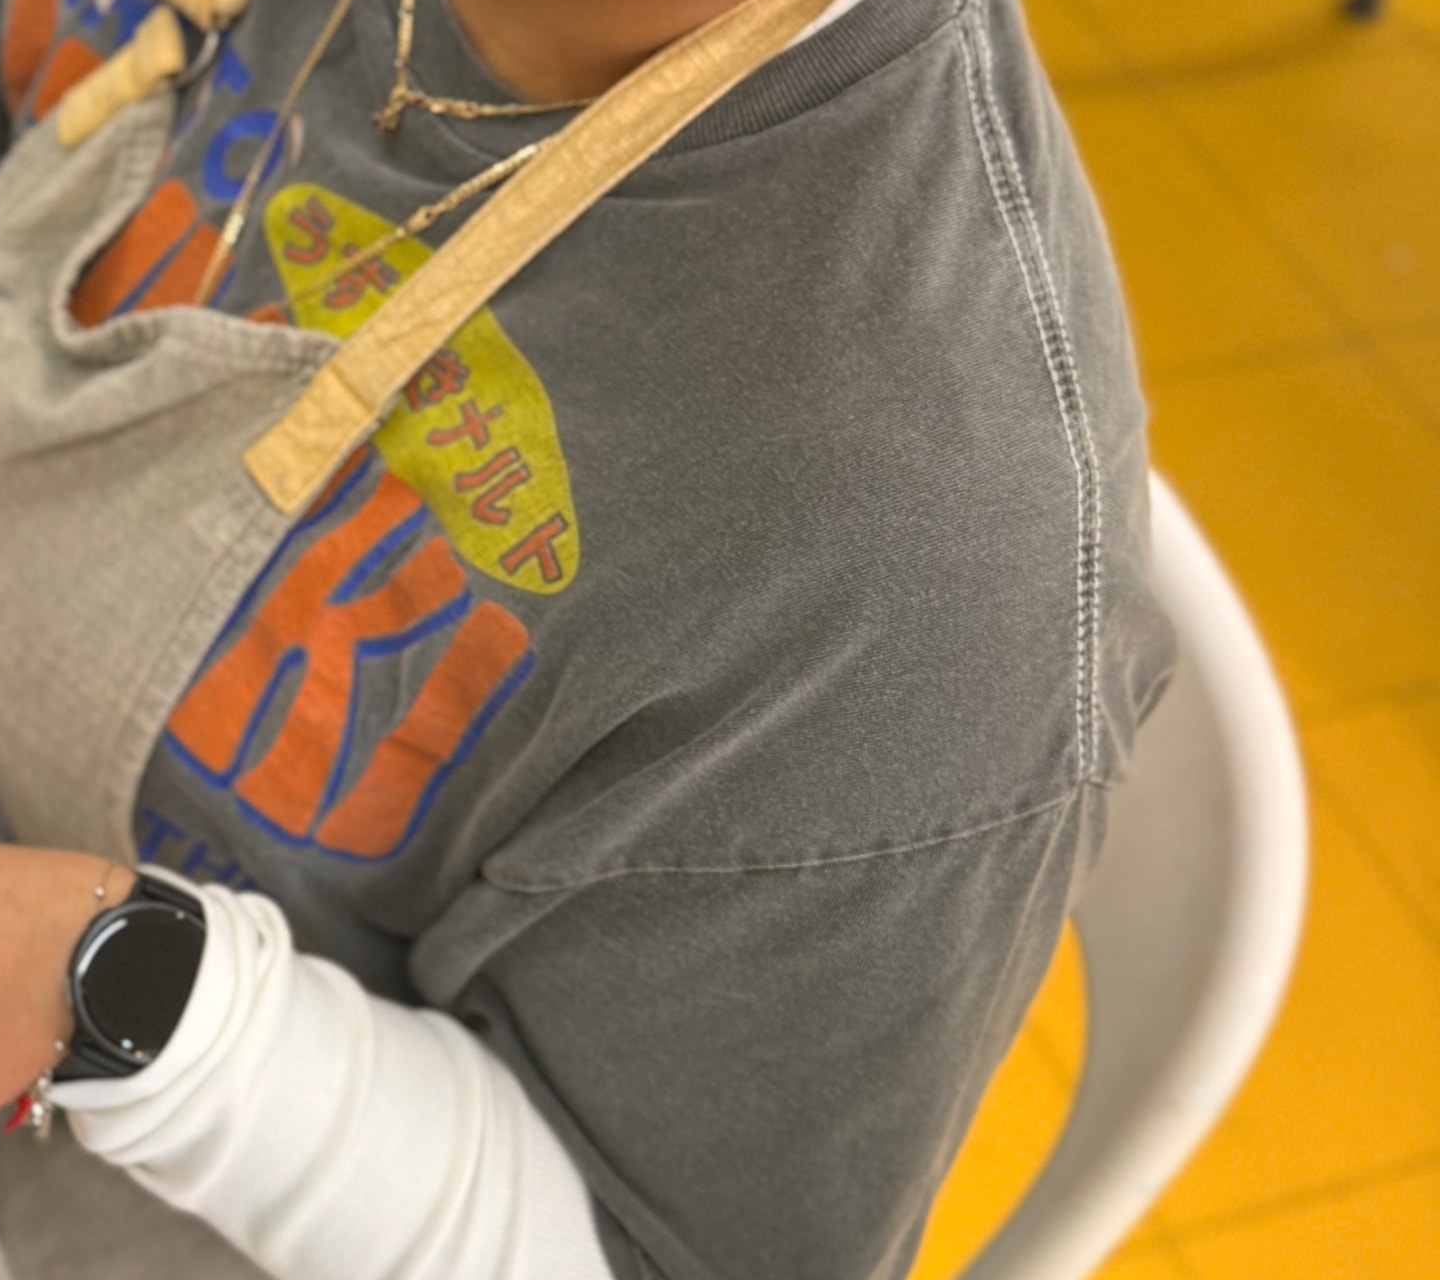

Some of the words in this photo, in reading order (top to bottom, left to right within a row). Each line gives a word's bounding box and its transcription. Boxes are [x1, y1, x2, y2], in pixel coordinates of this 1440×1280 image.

[281, 195, 570, 584] うずきナルト
